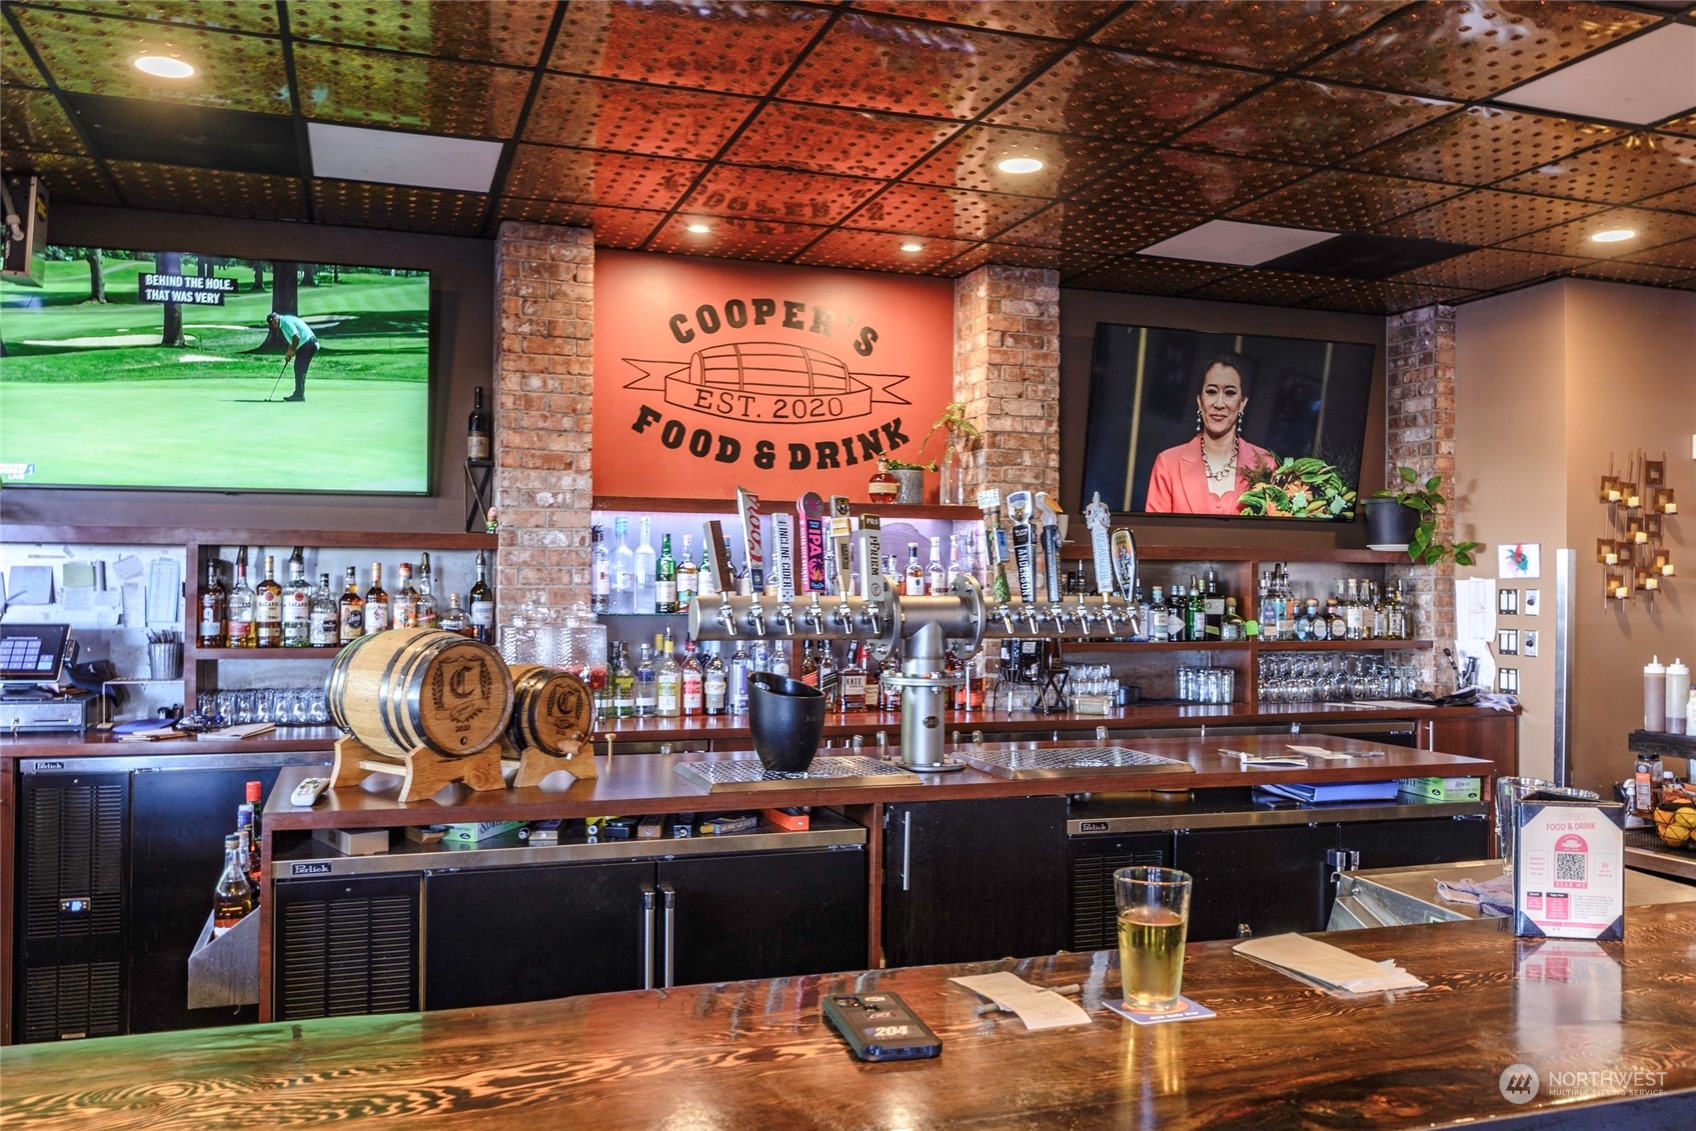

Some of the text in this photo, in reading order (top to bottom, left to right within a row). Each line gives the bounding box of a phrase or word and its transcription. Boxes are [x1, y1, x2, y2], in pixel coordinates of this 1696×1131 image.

[145, 274, 182, 287] BEHIND
[184, 277, 204, 289] THE
[145, 289, 220, 304] THAT WAS VERY
[669, 298, 878, 357] COOPER'S
[694, 388, 844, 420] EST. 2020
[631, 404, 910, 471] FOOD & DRINK
[746, 494, 763, 562] Coors
[808, 529, 822, 556] IPA
[778, 527, 792, 588] INCLINE CIDER
[1017, 548, 1032, 597] ANDERSON
[1546, 822, 1596, 831] FOOD & DRINK
[294, 864, 330, 874] Perlick
[874, 1025, 908, 1037] 204
